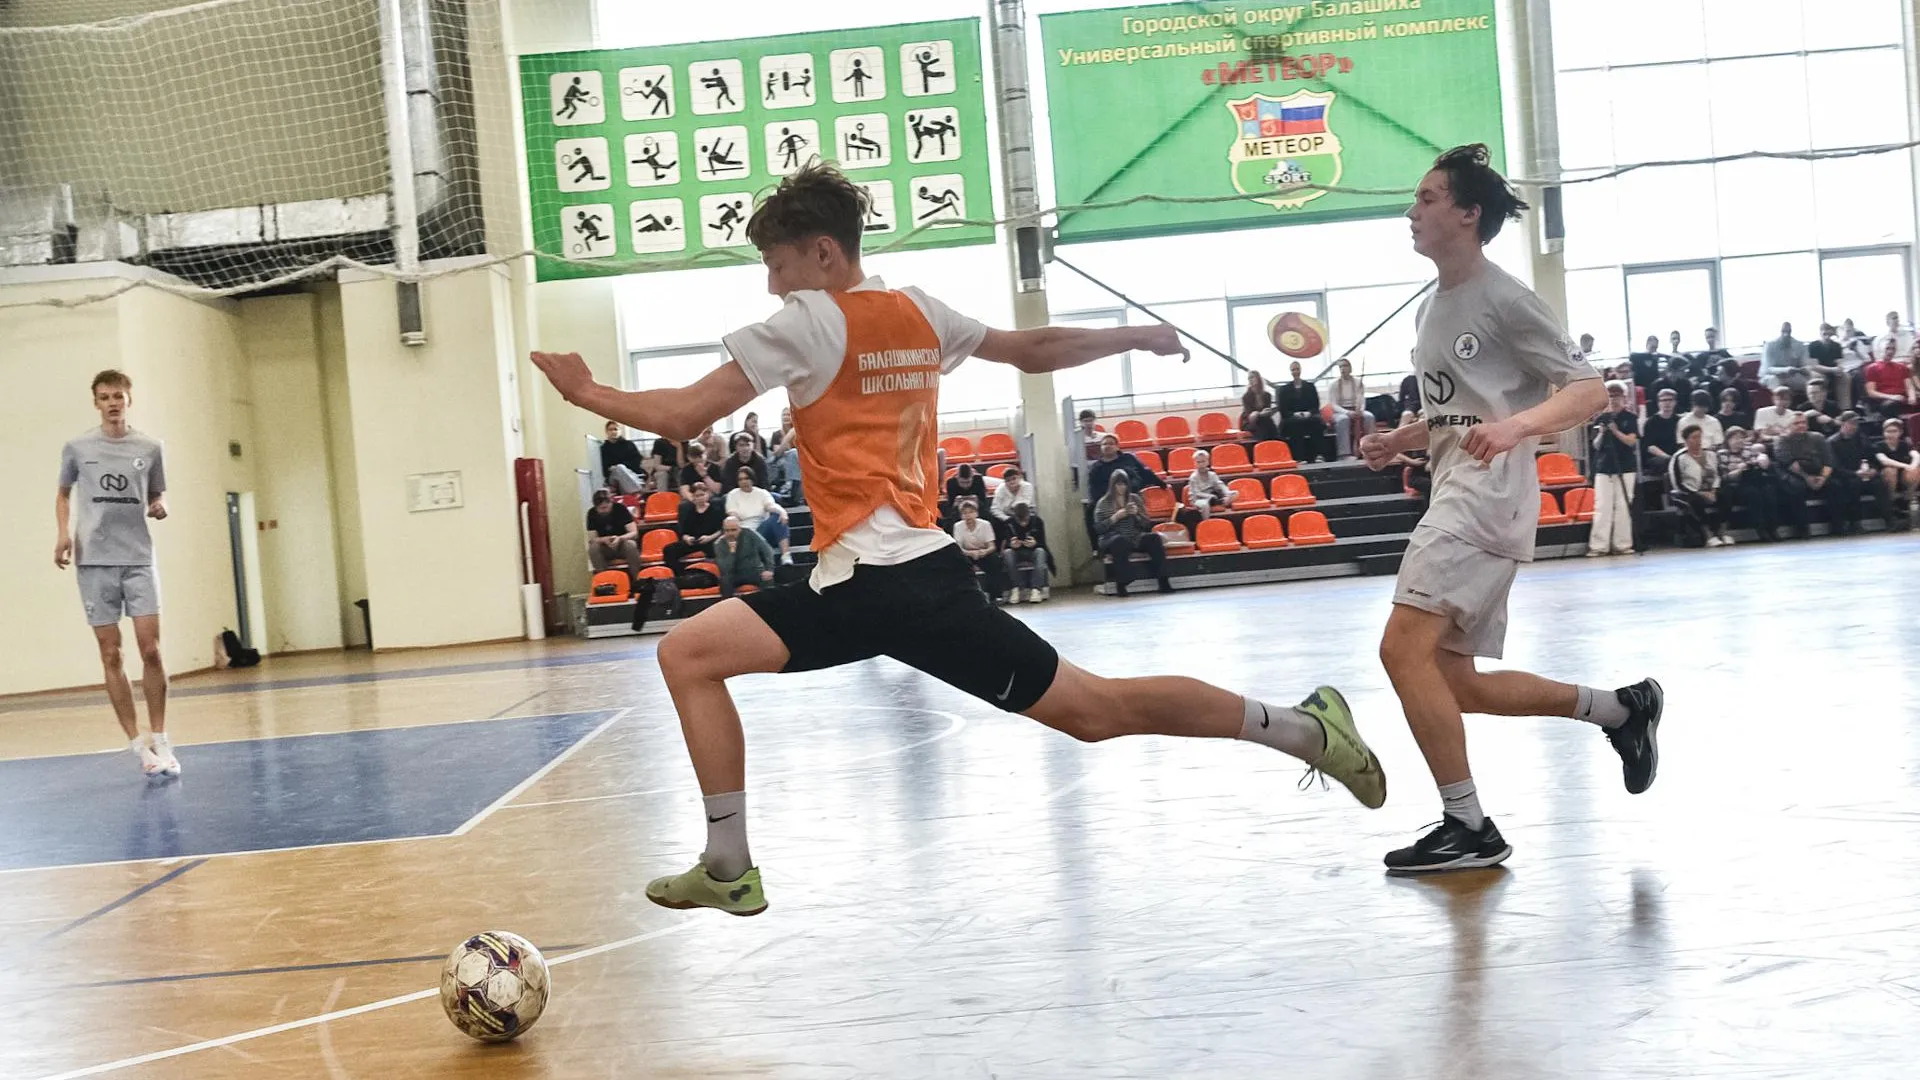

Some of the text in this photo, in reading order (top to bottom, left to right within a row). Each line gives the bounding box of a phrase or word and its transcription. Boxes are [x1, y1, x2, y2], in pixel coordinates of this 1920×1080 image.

[1122, 0, 1421, 36] Городской округ Балашиха
[1058, 14, 1490, 66] Универсальный спортивный комплекс
[1202, 53, 1353, 86] «МЕТЕОР»
[1245, 136, 1324, 156] МЕТЕОР
[862, 372, 925, 394] ШКОЛЬНАЯ
